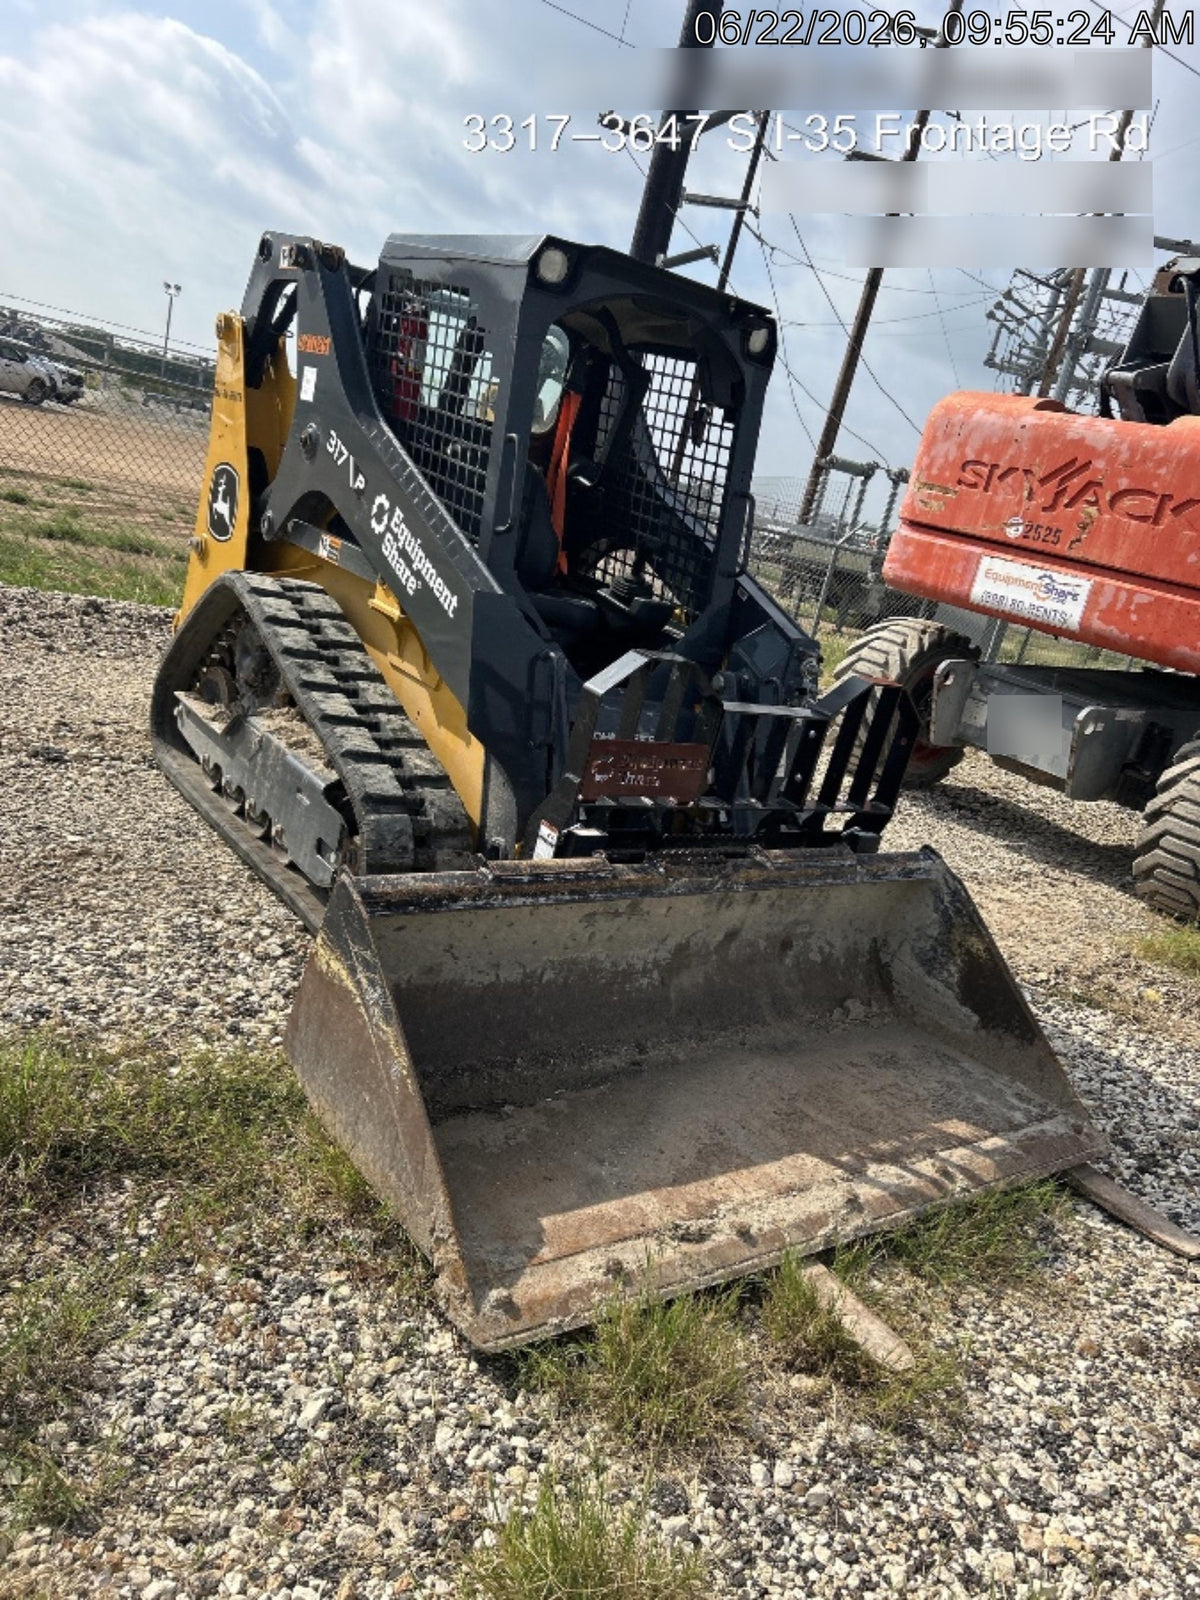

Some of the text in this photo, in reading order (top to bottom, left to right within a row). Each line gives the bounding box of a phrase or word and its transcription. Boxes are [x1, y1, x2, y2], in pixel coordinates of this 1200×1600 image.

[326, 429, 349, 467] 317
[1023, 520, 1063, 546] 2525
[381, 531, 418, 597] Share
[390, 506, 459, 619] Equipment
